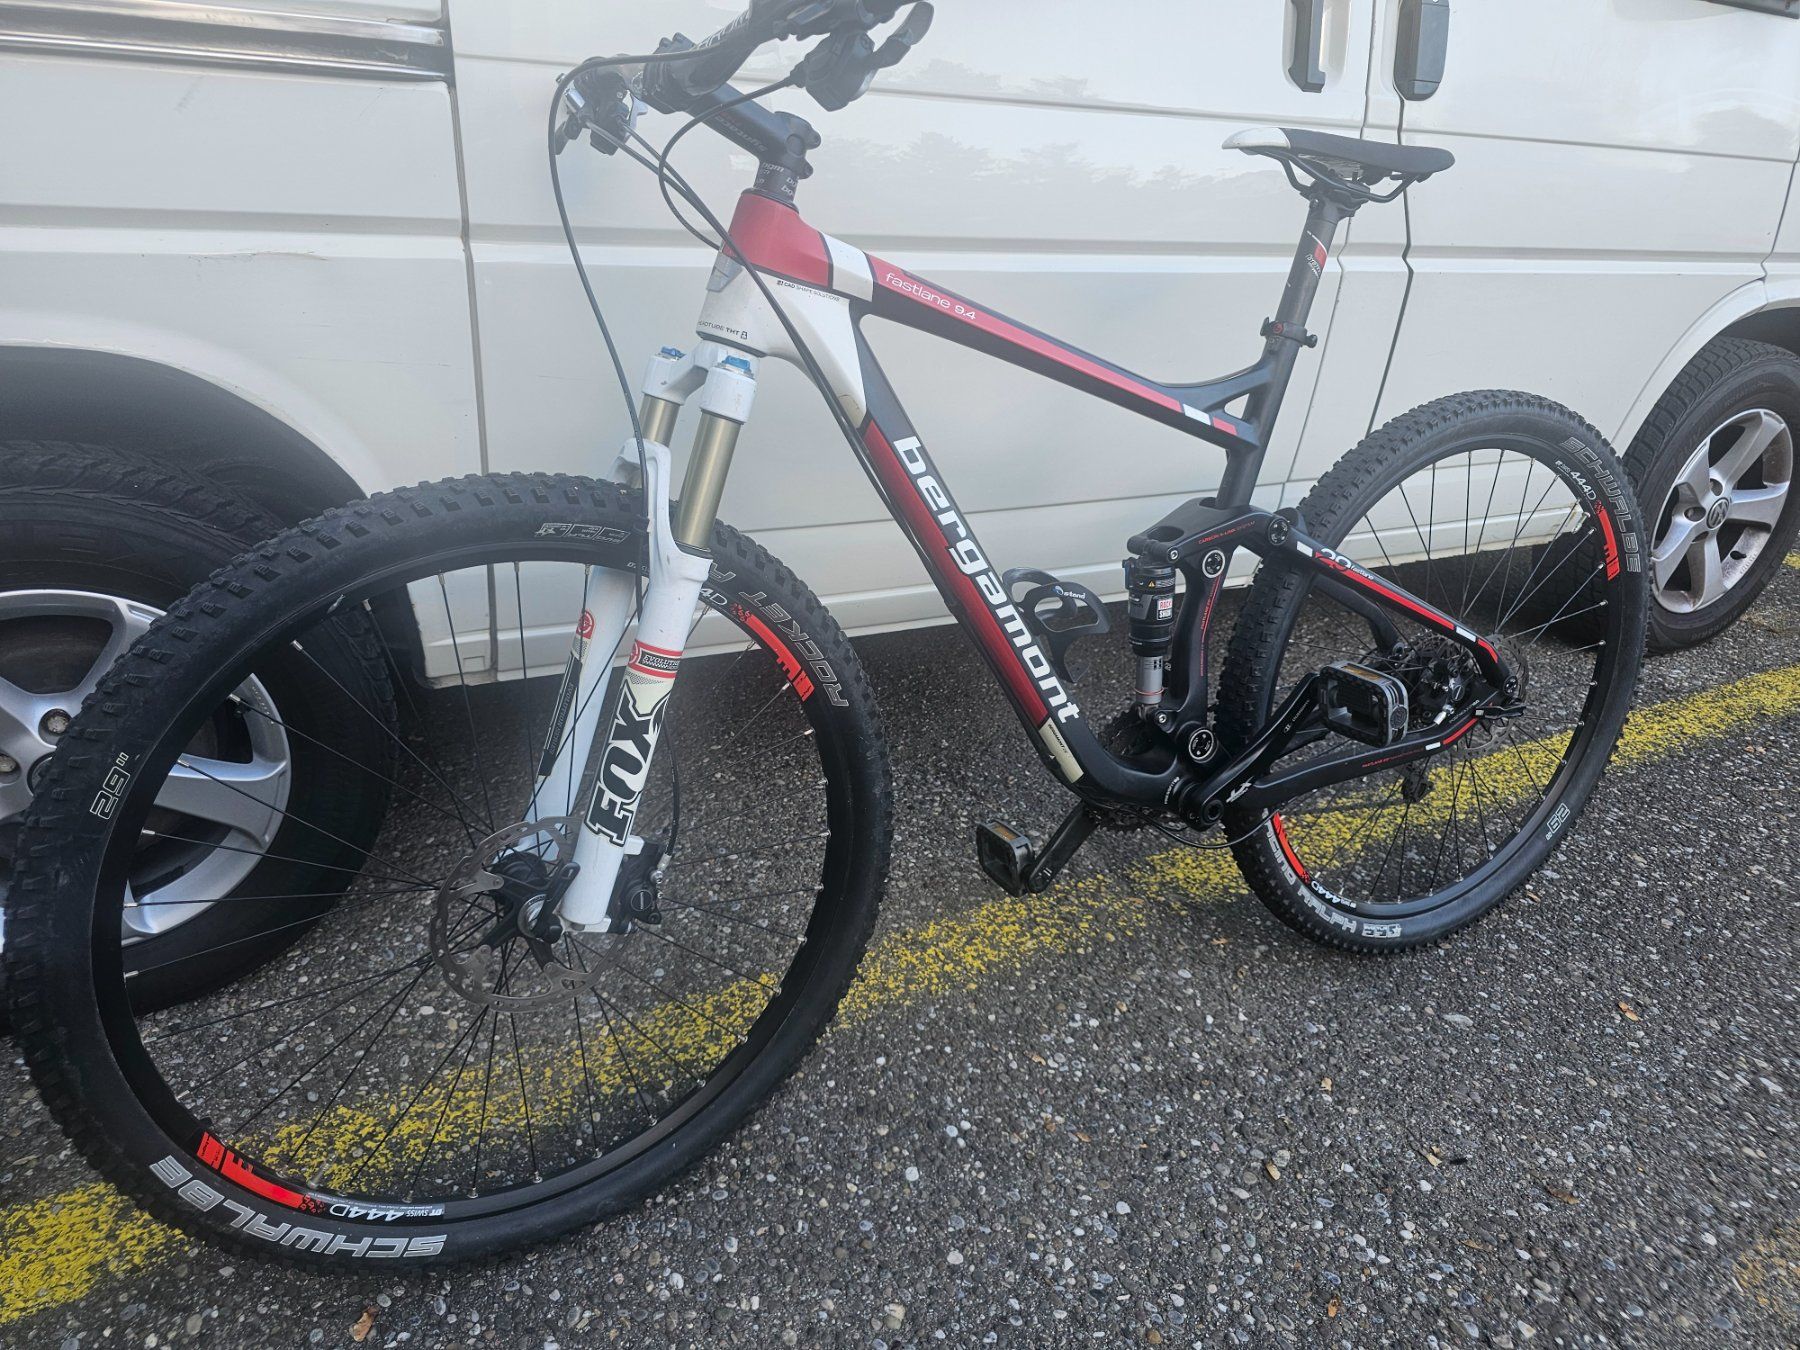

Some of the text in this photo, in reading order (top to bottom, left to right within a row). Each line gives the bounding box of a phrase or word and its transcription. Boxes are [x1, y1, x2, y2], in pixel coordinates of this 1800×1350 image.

[886, 272, 976, 320] fastlane 9.4
[1560, 436, 1642, 573] SCHWALBE
[1570, 471, 1597, 501] 444D
[893, 436, 1082, 725] bergamont
[739, 591, 850, 707] ROCKET
[90, 752, 129, 820] 29"
[584, 677, 672, 848] FOX
[1297, 884, 1357, 933] RALPH
[1310, 880, 1341, 904] 444D
[149, 1155, 448, 1258] SCHWALBE
[329, 1203, 443, 1222] DT SWISS 444D
